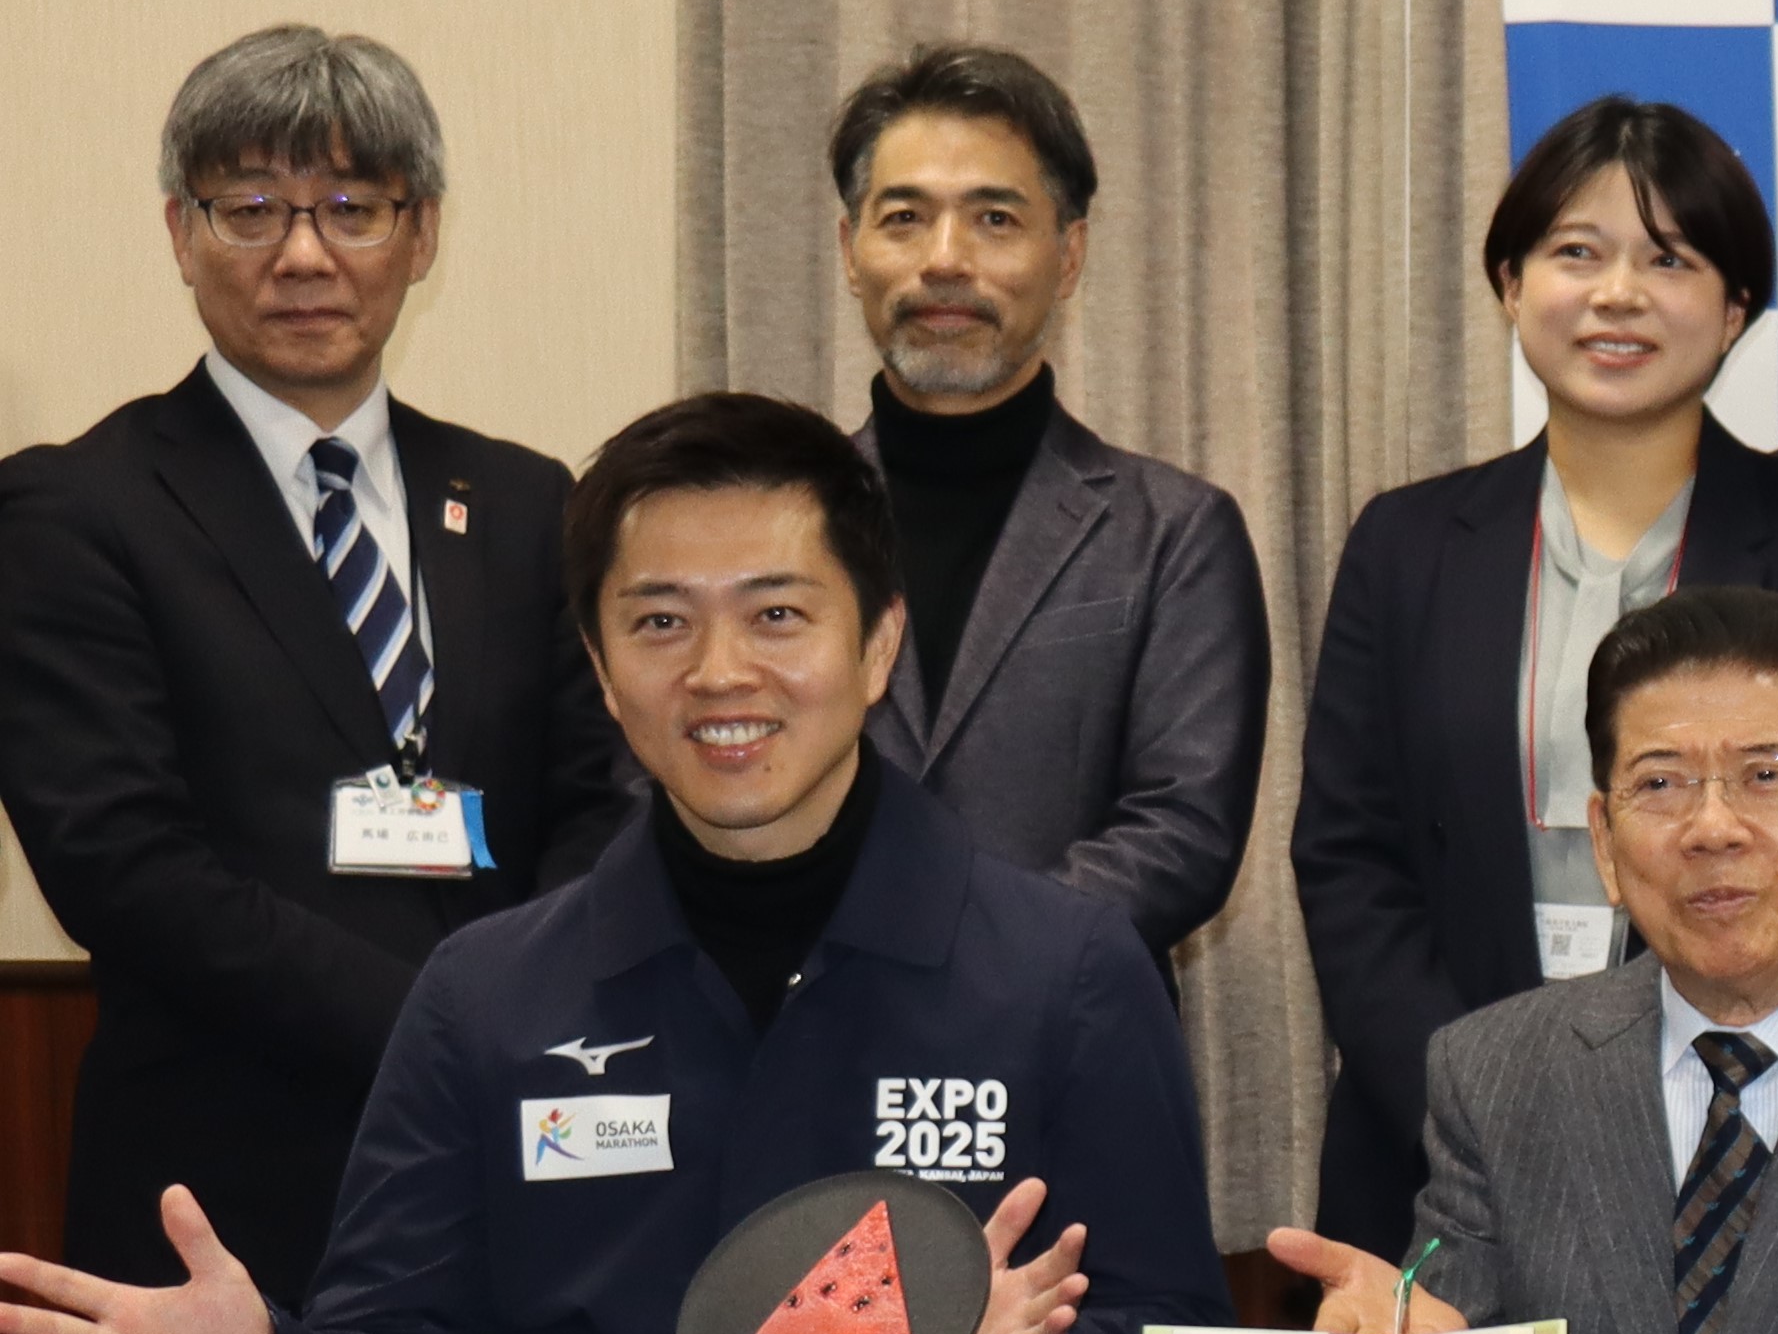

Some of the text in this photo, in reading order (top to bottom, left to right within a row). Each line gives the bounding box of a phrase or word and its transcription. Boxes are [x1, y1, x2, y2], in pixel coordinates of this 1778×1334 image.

[875, 1078, 1008, 1119] EXPO
[595, 1120, 657, 1138] OSAKA
[595, 1137, 659, 1151] MARATHON
[874, 1120, 1007, 1167] 2025
[968, 1169, 1004, 1181] JAPAN
